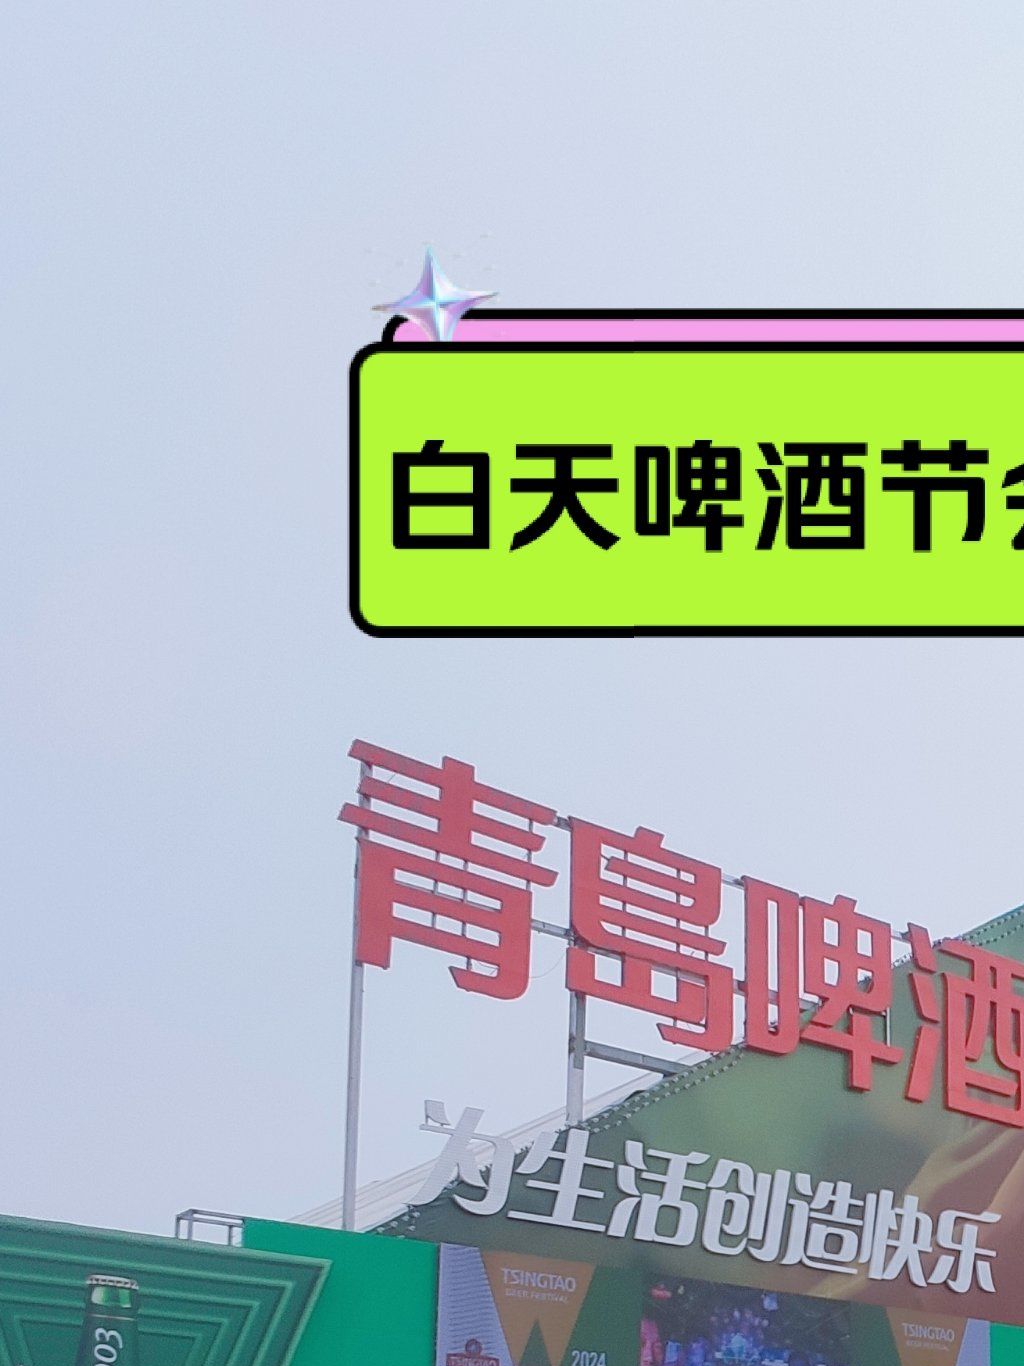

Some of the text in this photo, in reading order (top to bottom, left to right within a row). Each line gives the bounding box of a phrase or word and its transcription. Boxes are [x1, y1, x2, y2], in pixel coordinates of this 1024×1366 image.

[400, 1099, 1001, 1293] 为生活创造快乐
[502, 1268, 577, 1293] TSINGTAO
[902, 1323, 955, 1342] TSINGTAO
